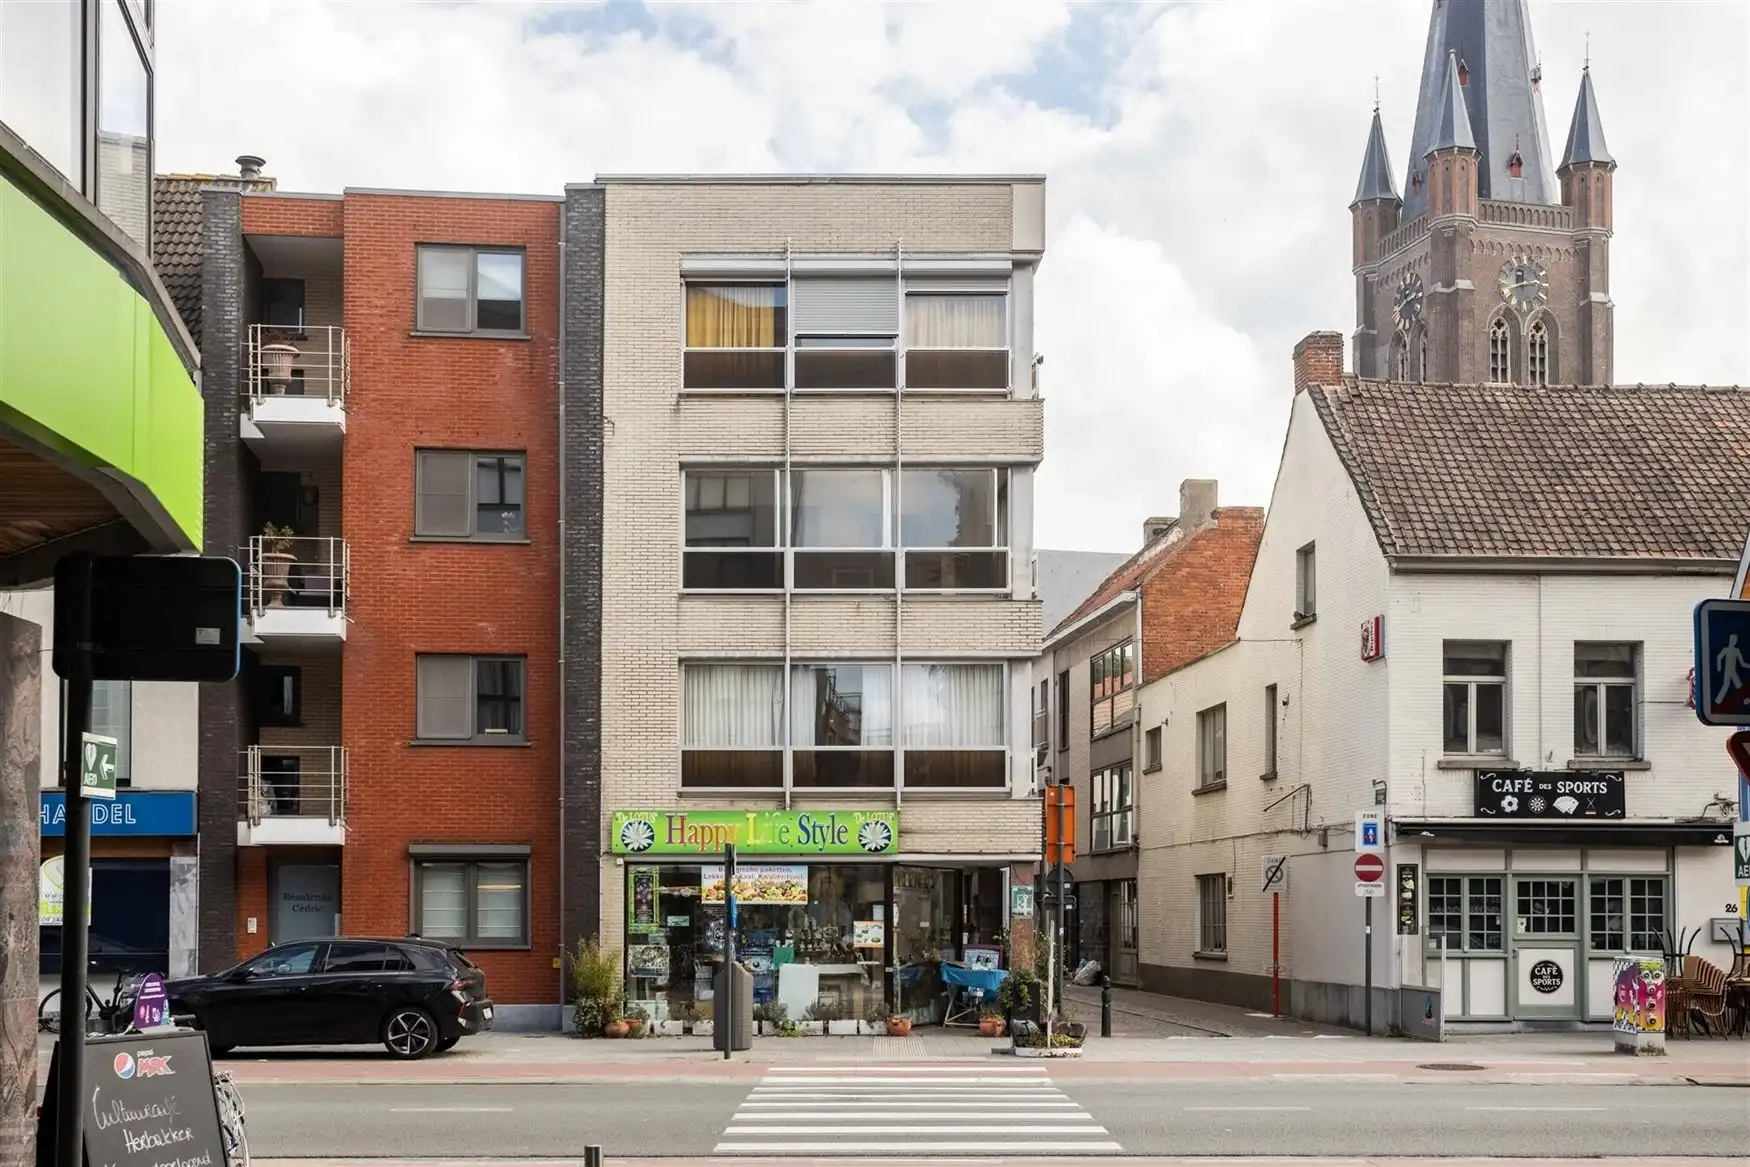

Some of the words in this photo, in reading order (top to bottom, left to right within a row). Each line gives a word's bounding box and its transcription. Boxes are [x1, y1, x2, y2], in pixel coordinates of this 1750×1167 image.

[83, 772, 97, 786] AED
[1491, 778, 1533, 793] CAFÉ
[1556, 781, 1608, 794] SPORTS
[40, 803, 136, 824] HADEL
[665, 812, 742, 852] Happy
[745, 811, 790, 845] Life
[797, 811, 849, 851] Style
[1738, 864, 1750, 878] AE
[1725, 903, 1738, 914] 26
[1532, 978, 1561, 986] SPORTS
[136, 1048, 154, 1057] pepsi
[136, 1055, 176, 1078] MAX
